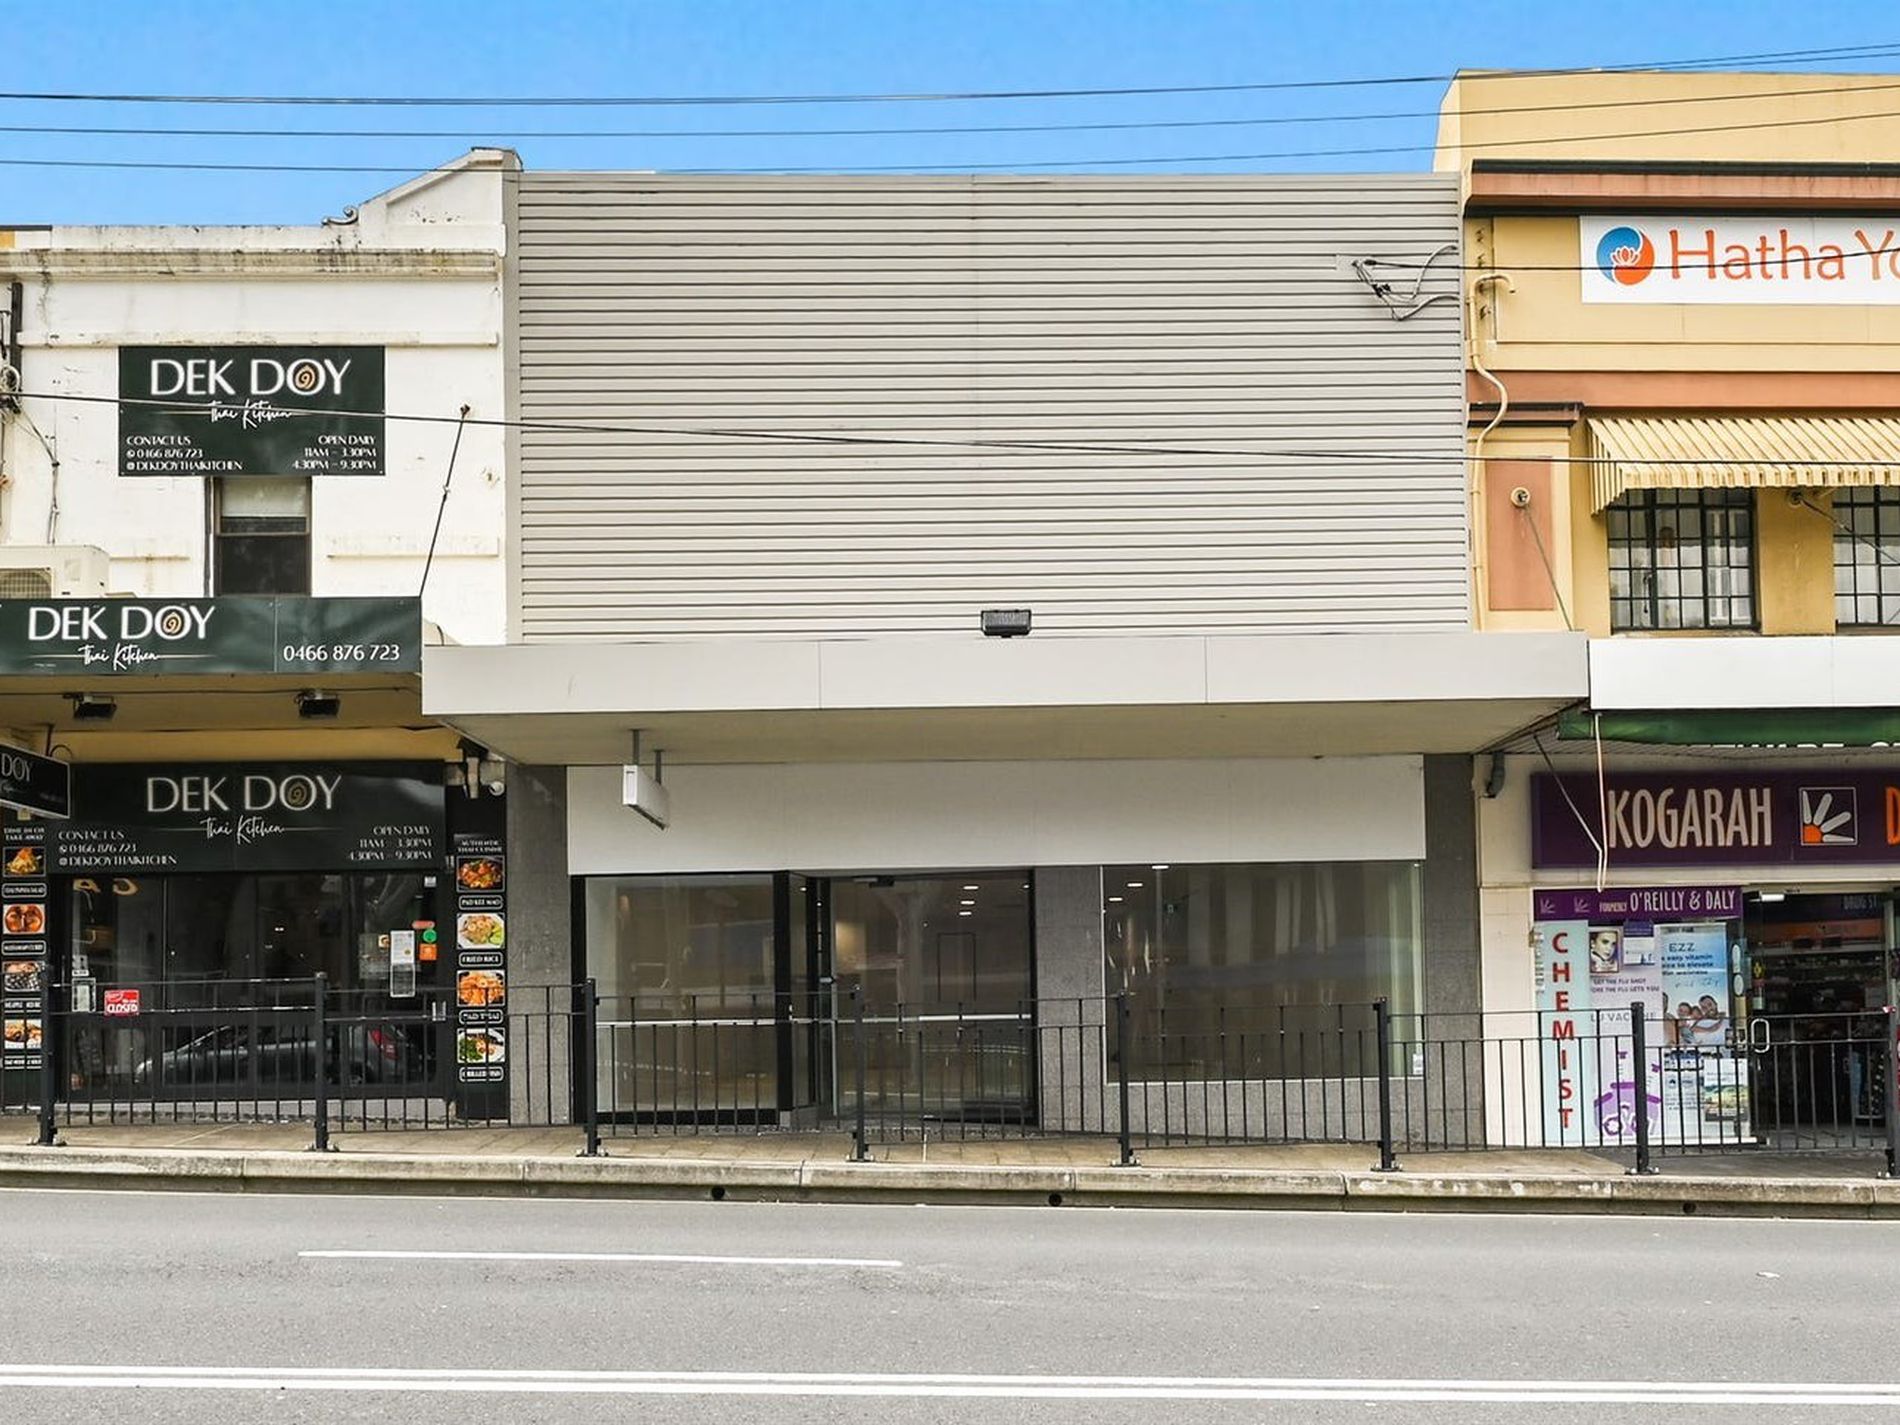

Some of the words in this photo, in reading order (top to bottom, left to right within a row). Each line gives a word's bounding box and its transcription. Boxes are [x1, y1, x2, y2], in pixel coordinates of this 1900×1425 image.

[1669, 229, 1845, 280] Hatha
[151, 359, 236, 396] DEK
[251, 359, 351, 396] DOY
[126, 435, 175, 446] CONTACT
[178, 435, 191, 446] US
[318, 434, 347, 445] OPEN
[348, 434, 376, 445] DAILY
[136, 449, 163, 459] 0466
[164, 449, 183, 459] 876
[184, 449, 203, 459] 723
[304, 447, 330, 457] 11AM
[28, 606, 108, 640] DEK
[121, 605, 216, 640] DOY
[78, 644, 110, 665] Thai
[113, 642, 161, 671] Kitchen
[283, 645, 329, 661] 0466
[332, 645, 365, 661] 876
[369, 644, 401, 661] 723
[1, 752, 31, 781] DOY
[147, 776, 230, 812] DEK
[244, 775, 342, 811] DOY
[1607, 788, 1773, 848] KOGARAH
[58, 830, 108, 840] CONTACT
[110, 830, 125, 839] US
[200, 817, 233, 839] Thai
[237, 815, 286, 845] Kitchen
[373, 825, 402, 836] OPEN
[403, 825, 430, 835] DAILY
[119, 843, 137, 853] 723
[360, 838, 385, 848] 11AM
[1630, 891, 1686, 912] O'REILLY
[1689, 890, 1701, 910] &
[1706, 890, 1736, 910] DALY
[1668, 943, 1696, 953] EZZ
[1552, 932, 1575, 1129] CHEMIST
